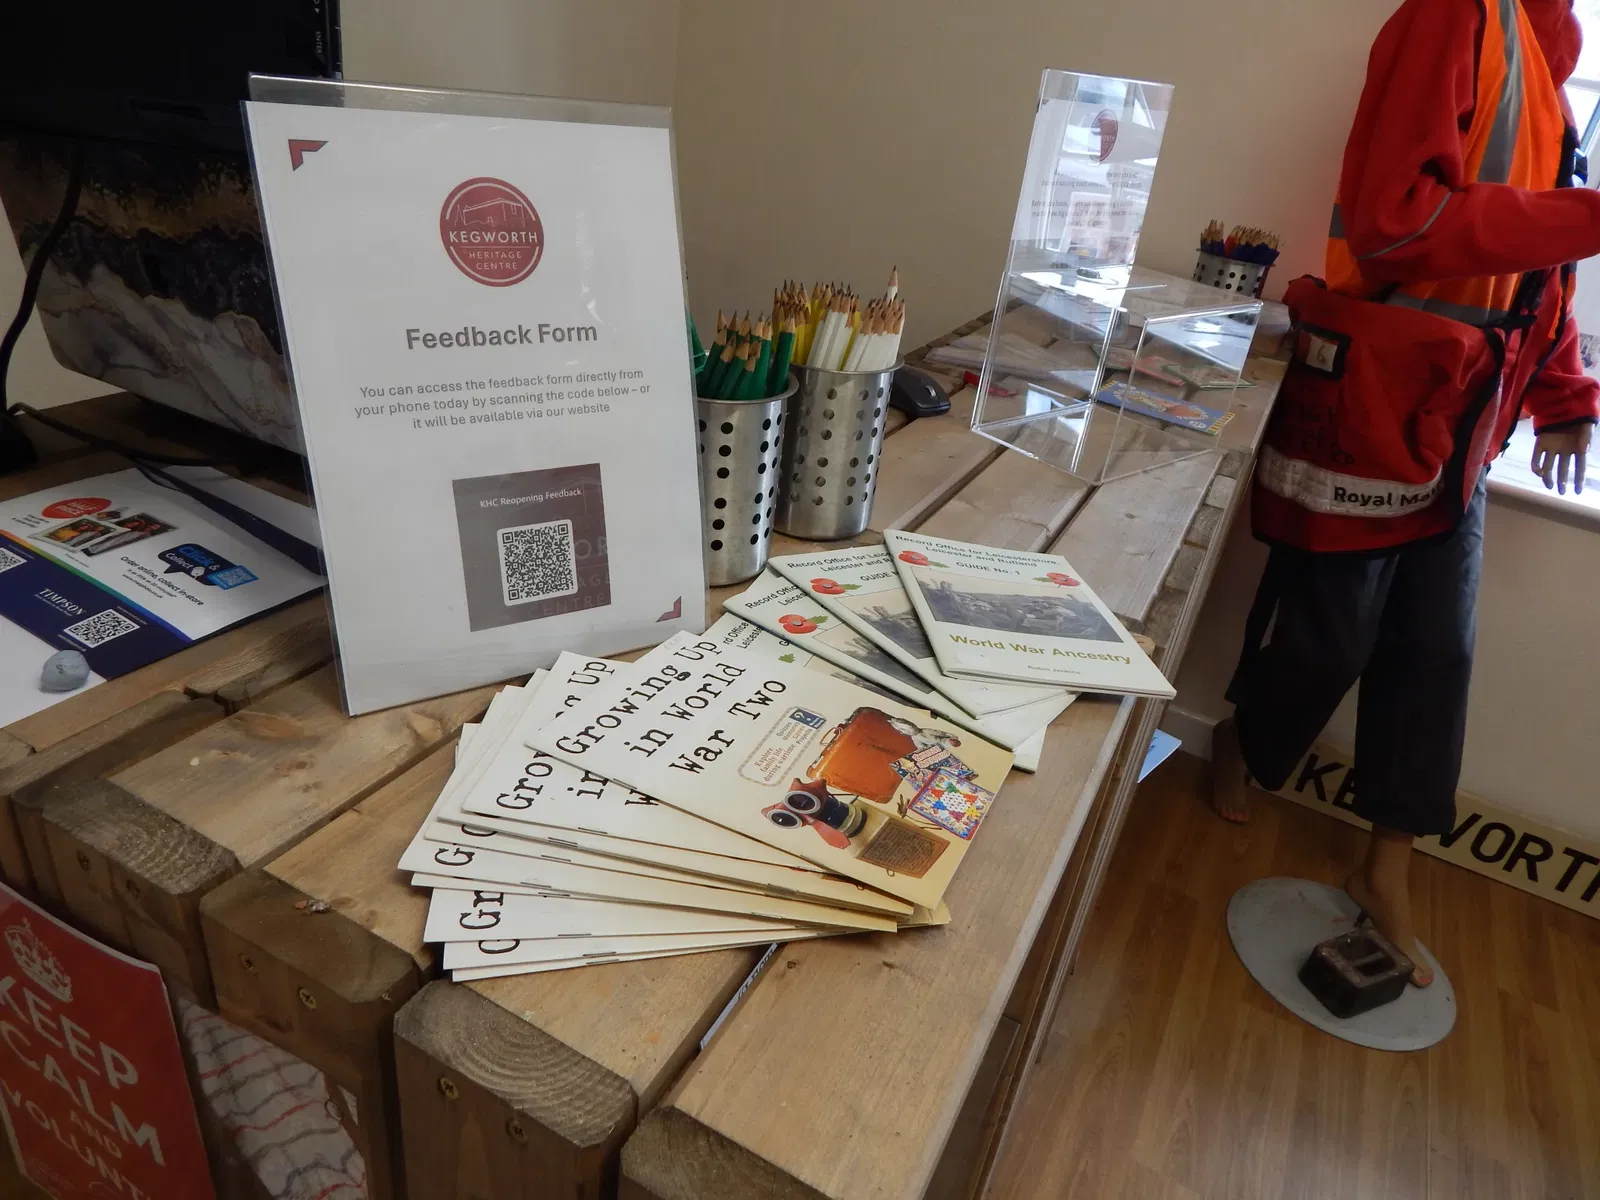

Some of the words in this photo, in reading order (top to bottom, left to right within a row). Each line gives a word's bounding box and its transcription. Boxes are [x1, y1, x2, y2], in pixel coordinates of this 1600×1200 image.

[449, 230, 538, 243] KEGWORTH
[468, 251, 522, 259] HERITAGE
[475, 262, 518, 270] CENTRE
[405, 324, 533, 350] Feedback
[538, 323, 598, 343] Form
[359, 386, 385, 398] You
[388, 385, 413, 396] can
[417, 382, 463, 394] access
[465, 380, 486, 391] the
[488, 375, 544, 389] feedback
[546, 374, 573, 385] form
[576, 370, 617, 382] directly
[619, 369, 644, 380] from
[355, 405, 385, 418] your
[389, 401, 431, 415] phone
[434, 398, 469, 410] today
[472, 396, 487, 408] by
[489, 391, 544, 405] scanning
[546, 390, 565, 401] the
[567, 388, 595, 399] code
[597, 385, 629, 397] below
[640, 384, 651, 394] or
[412, 417, 422, 429] it
[424, 415, 448, 428] will
[450, 414, 466, 426] be
[469, 409, 524, 424] available
[526, 407, 543, 419] via
[546, 407, 565, 418] our
[567, 401, 610, 415] website
[479, 498, 499, 508] KHC
[500, 493, 544, 506] Reopening
[545, 487, 582, 500] Feedback
[1333, 485, 1393, 507] Royal
[787, 558, 821, 569] Record
[823, 556, 852, 565] Office
[895, 535, 933, 547] Record
[935, 543, 966, 553] Office
[968, 547, 982, 556] for
[985, 550, 1061, 566] Leicestershire,
[925, 546, 973, 559] Leicester
[975, 553, 995, 562] and
[997, 557, 1038, 568] Rutland
[820, 561, 864, 572] Leicester
[866, 558, 883, 567] and
[860, 571, 889, 582] GUIDE
[955, 561, 993, 572] GUIDE
[993, 567, 1013, 575] No.
[38, 587, 86, 616] TIMPSON
[745, 592, 779, 609] Record
[728, 621, 750, 639] Office
[949, 634, 1005, 650] World
[1008, 642, 1045, 655] War
[1052, 648, 1131, 665] Ancestry
[567, 661, 616, 687] Up
[555, 664, 692, 754] Growing
[673, 639, 723, 662] Up
[623, 728, 674, 757] in
[660, 662, 747, 721] World
[669, 728, 735, 774] War
[728, 680, 787, 721] Two
[754, 747, 773, 767] Explore
[759, 756, 777, 773] family
[772, 747, 785, 758] life
[763, 764, 782, 782] during
[779, 743, 796, 765] wartime
[0, 1020, 165, 1167] CALM
[0, 1077, 150, 1200] VOLUNT
[69, 1109, 123, 1160] AND
